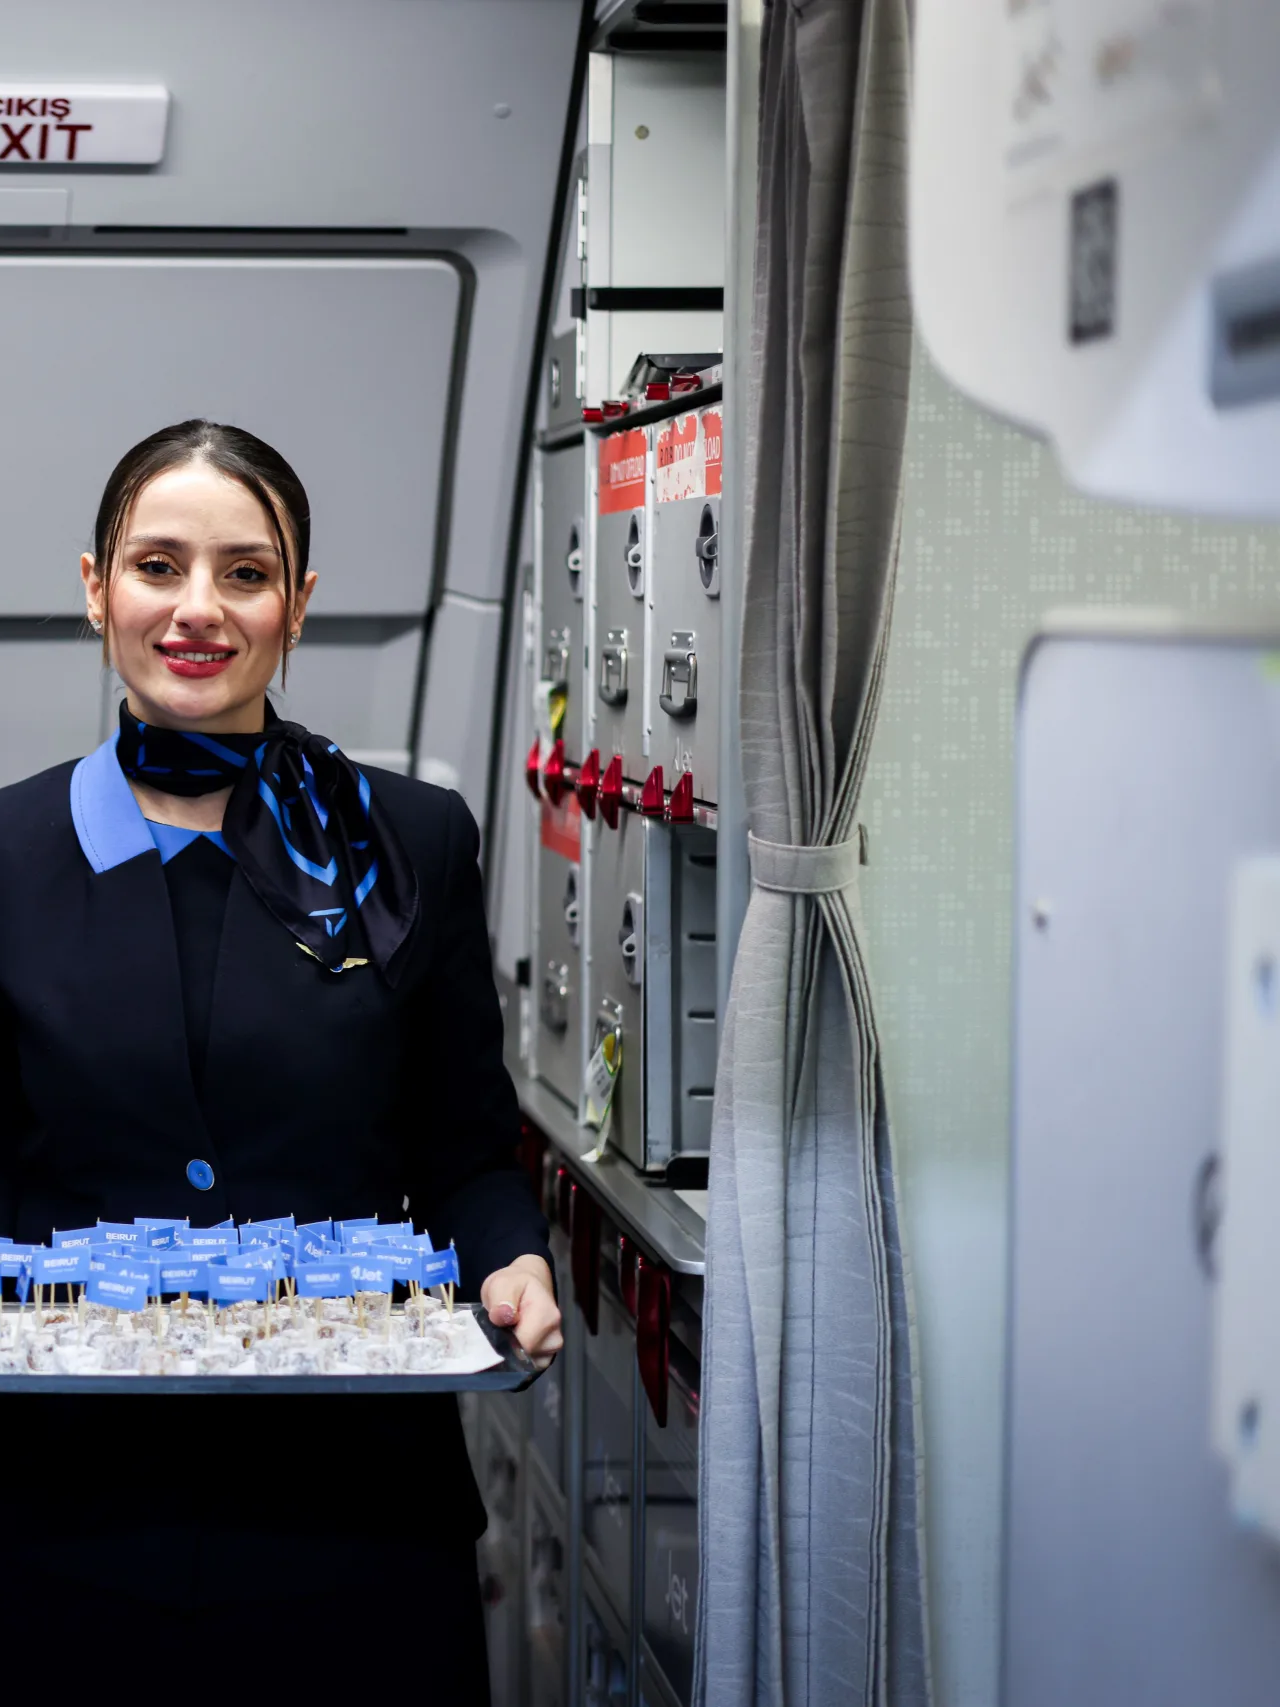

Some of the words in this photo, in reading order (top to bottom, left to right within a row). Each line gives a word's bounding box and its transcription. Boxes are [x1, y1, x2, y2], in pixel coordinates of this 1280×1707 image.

[105, 1232, 138, 1242] BEIRUT
[152, 1236, 170, 1247] BEIRUT
[61, 1237, 91, 1248] BEIRUT
[1, 1253, 33, 1263] BEIRUT
[43, 1257, 80, 1268] BEIRUT
[161, 1268, 198, 1278] BEIRUT
[305, 1273, 341, 1283] BEIRUT
[218, 1276, 256, 1285] BEIRUT
[98, 1281, 137, 1294] BEIRUT
